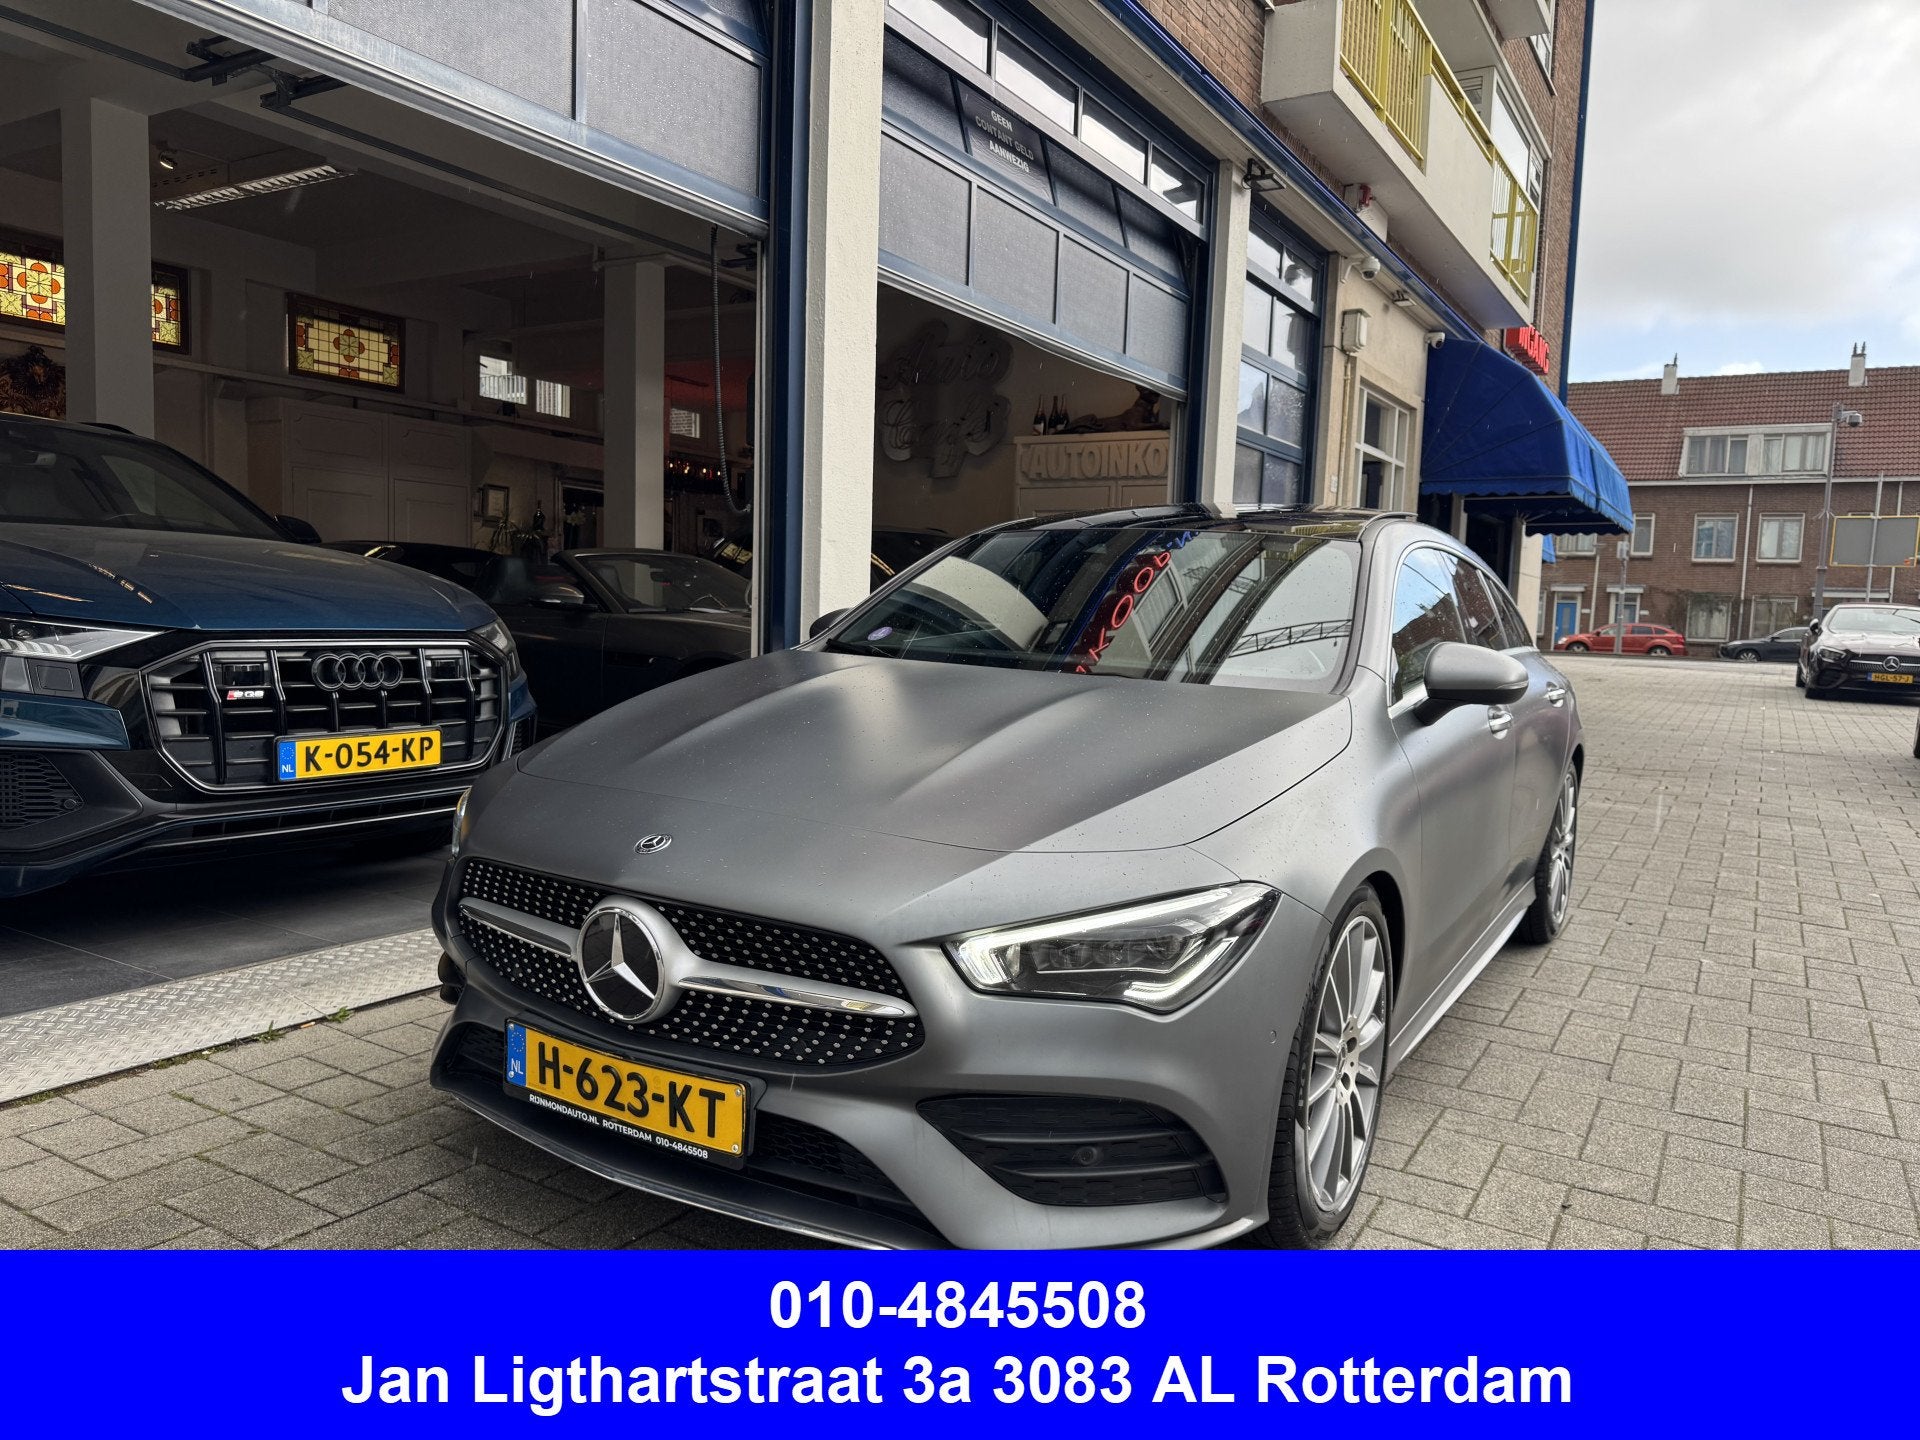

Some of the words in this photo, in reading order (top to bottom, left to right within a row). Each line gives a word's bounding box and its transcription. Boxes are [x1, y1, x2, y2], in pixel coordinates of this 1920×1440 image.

[975, 116, 1013, 147] CONTANT
[1014, 140, 1034, 160] GELD
[990, 110, 1013, 132] GEEN
[989, 140, 1030, 173] AANWEZIG
[282, 764, 294, 774] NL
[305, 736, 434, 772] K-054-KP
[510, 1058, 524, 1075] NL
[537, 1041, 726, 1138] H-623-KT
[529, 1093, 600, 1125] RIJNMONDAUTO.NL
[602, 1119, 652, 1142] ROTTERDAM
[655, 1136, 708, 1159] 010-4845508
